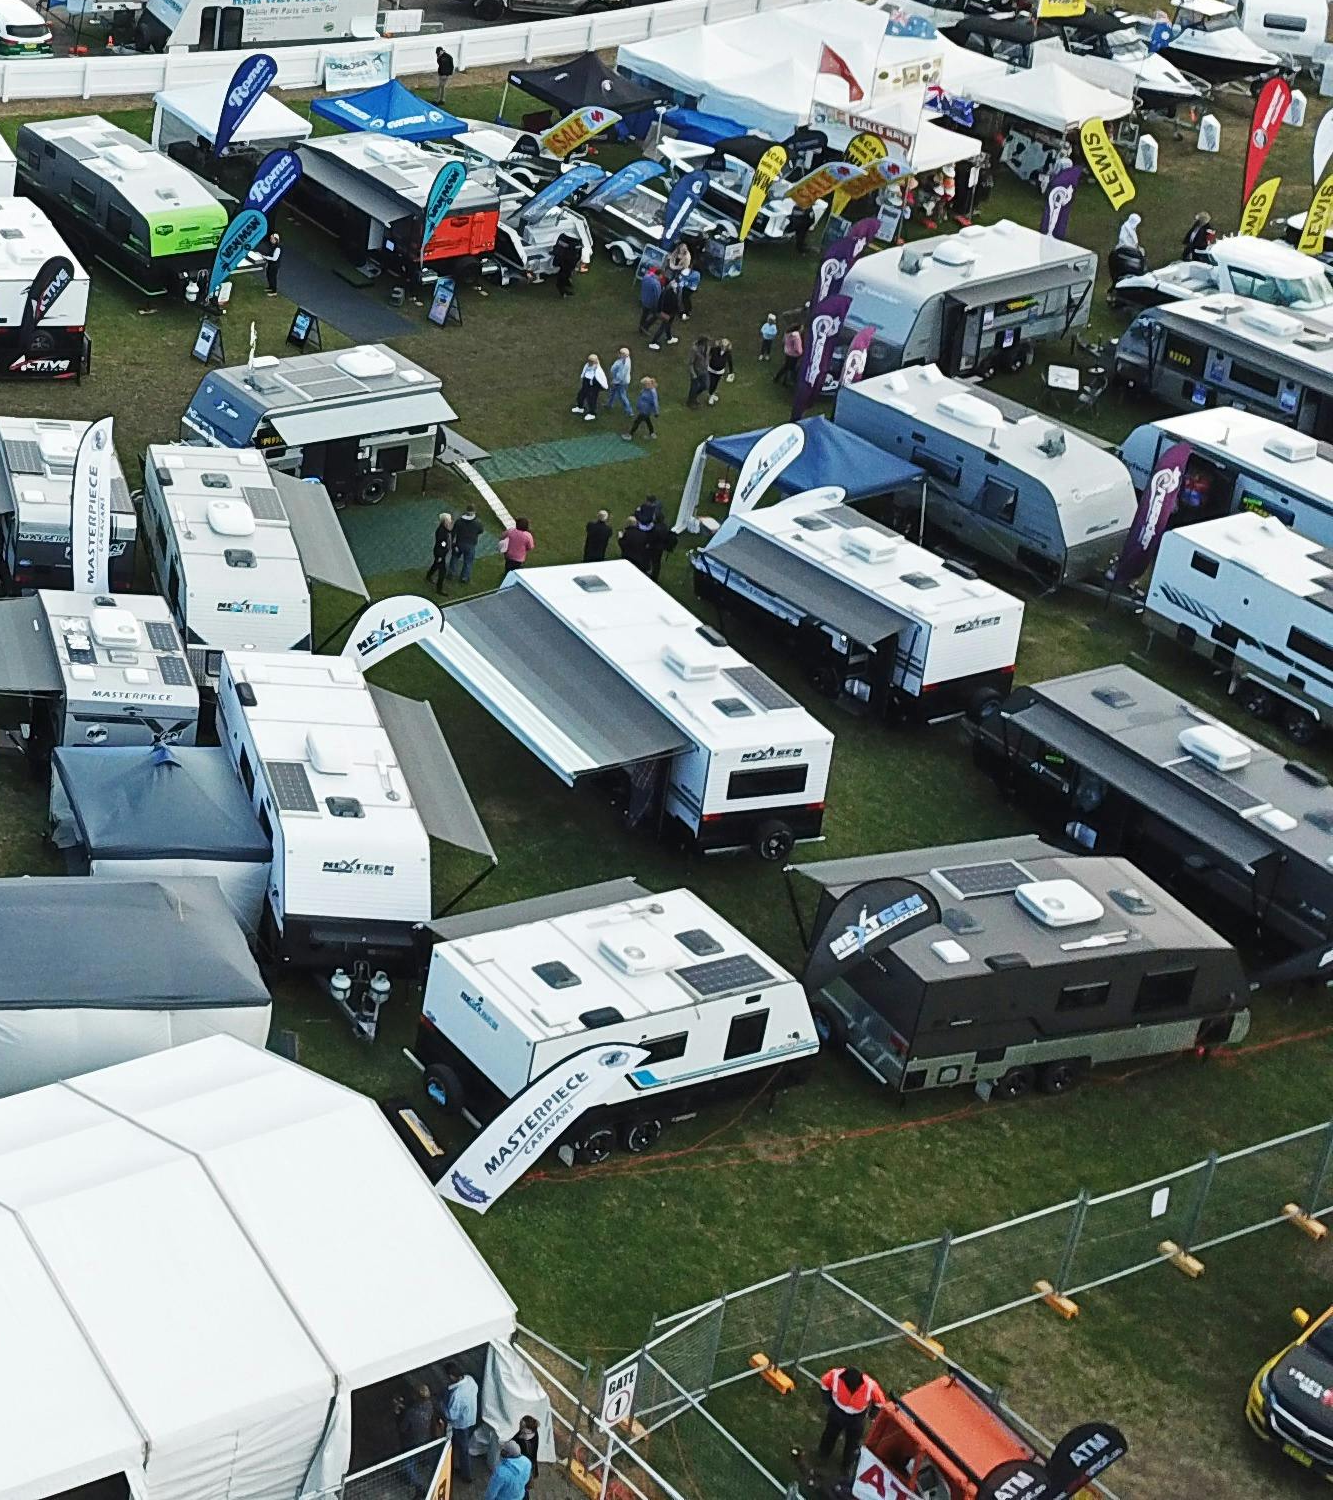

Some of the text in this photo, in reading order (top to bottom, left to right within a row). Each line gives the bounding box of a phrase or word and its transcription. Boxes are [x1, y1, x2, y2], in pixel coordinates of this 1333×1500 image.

[225, 53, 269, 110] Roma
[245, 149, 295, 205] Roma
[1082, 128, 1126, 200] LEWIS
[1302, 180, 1333, 251] LEWIS
[10, 353, 70, 372] ACTIVE
[85, 464, 98, 584] MASTERPIECE
[356, 607, 433, 656] NEXTGEN
[92, 688, 173, 702] MASTERPIECE
[741, 746, 803, 762] NEXTGEN
[322, 854, 394, 876] NEXTGEN
[484, 1071, 589, 1177] MASTERPIECE
[523, 1103, 574, 1156] CARAVANS
[608, 1369, 635, 1394] GATE
[614, 1398, 623, 1417] 1
[1069, 1433, 1110, 1467] ATM
[993, 1471, 1035, 1500] ATM
